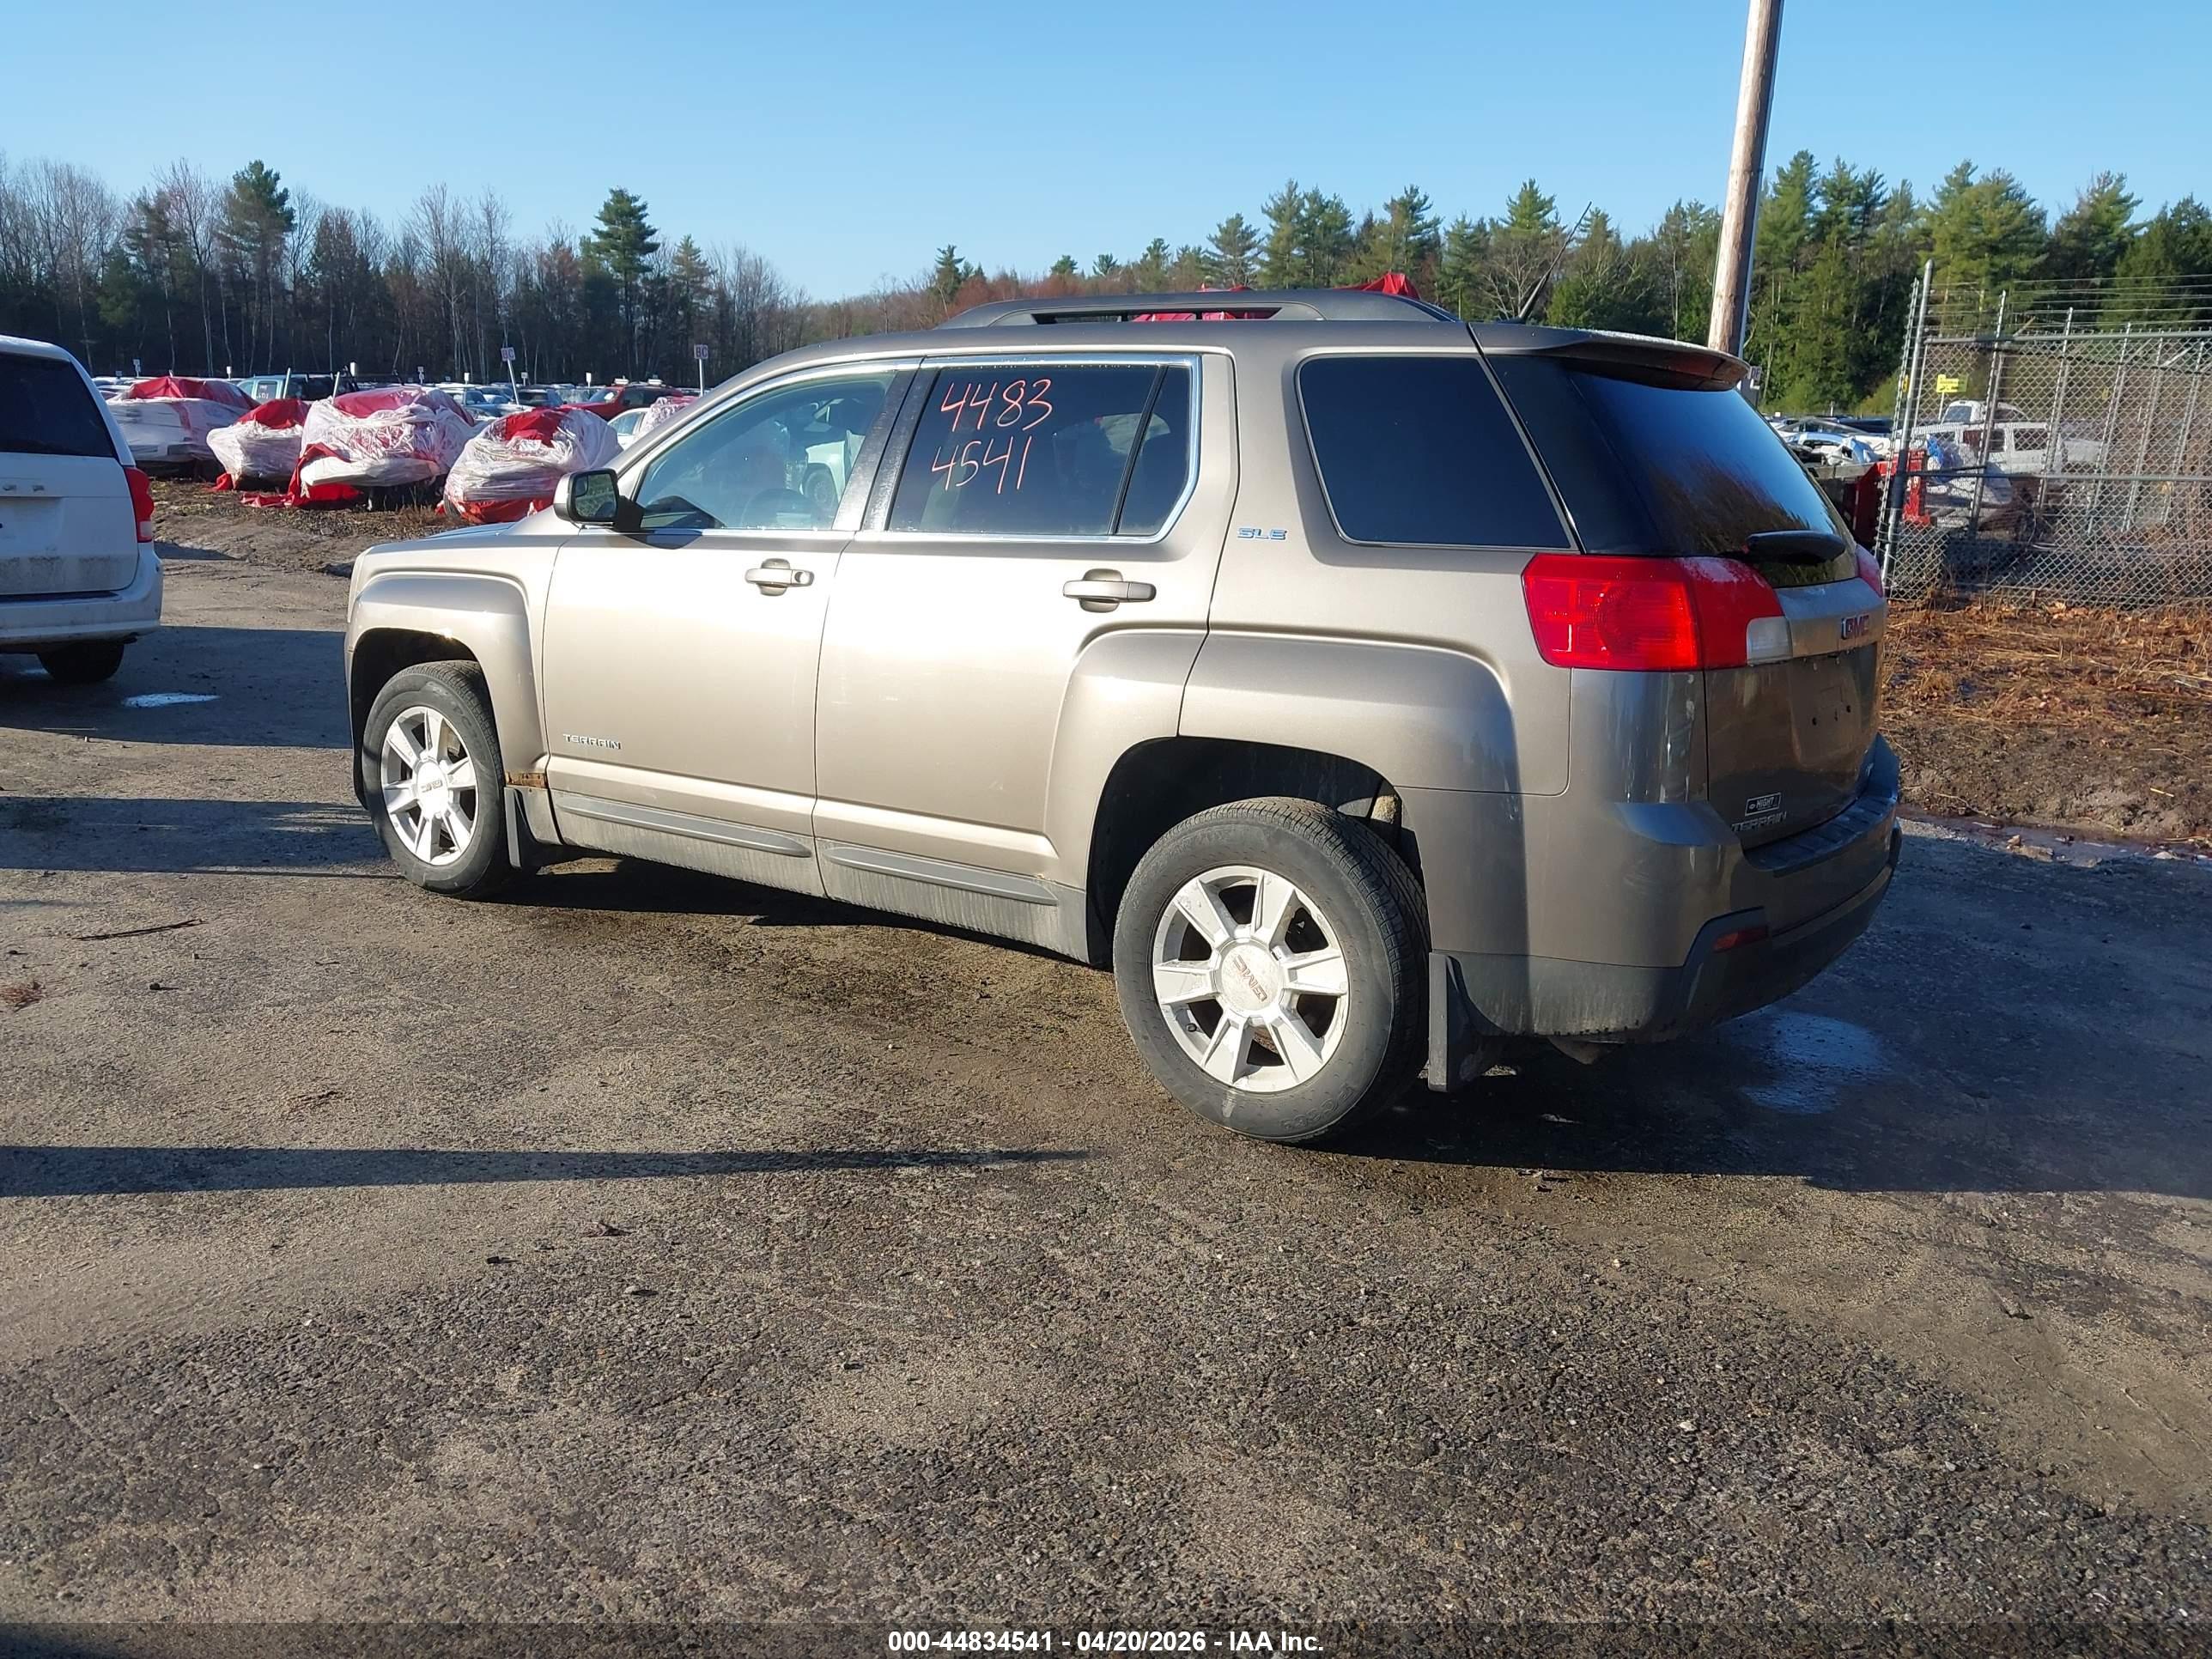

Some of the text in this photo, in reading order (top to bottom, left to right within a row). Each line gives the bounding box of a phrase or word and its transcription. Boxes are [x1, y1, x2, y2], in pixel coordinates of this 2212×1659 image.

[940, 379, 1053, 432] 4483
[932, 435, 1032, 495] 4541
[1237, 527, 1287, 540] SLE
[562, 733, 622, 750] TERRAIN
[1233, 954, 1268, 1002] GMC
